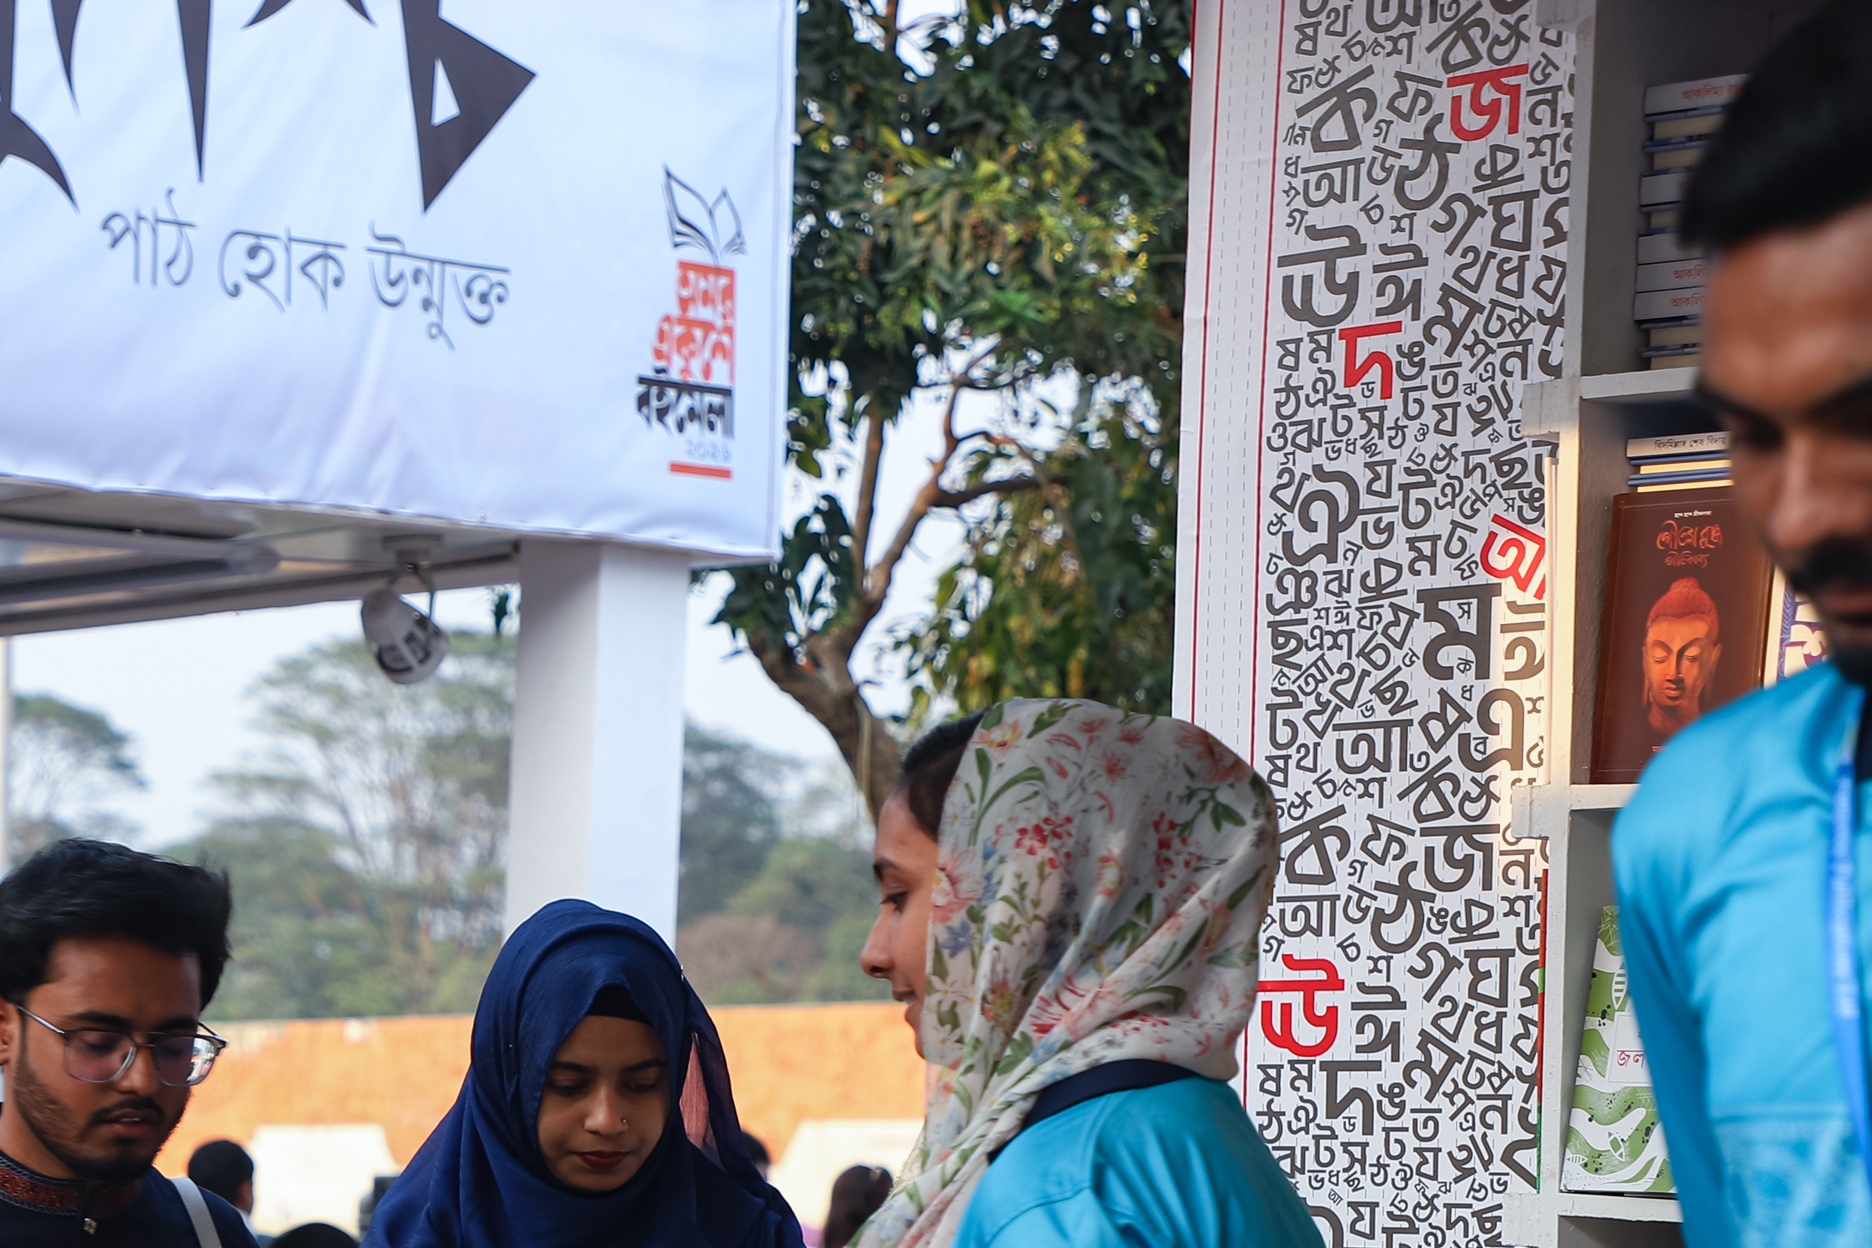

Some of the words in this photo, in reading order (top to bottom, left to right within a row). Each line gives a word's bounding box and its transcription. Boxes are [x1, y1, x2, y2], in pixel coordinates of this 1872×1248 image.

[1425, 3, 1490, 74] ক
[1295, 64, 1377, 153] ক
[1448, 65, 1528, 141] জ
[1525, 84, 1564, 128] ন
[1301, 157, 1365, 208] আ
[1487, 189, 1540, 252] ঘ
[100, 187, 197, 288] পাঠ
[217, 226, 348, 313] হোক
[365, 220, 512, 351] উন্মুক্ত
[1277, 224, 1367, 328] ঊ
[1372, 243, 1429, 321] ঈ
[1452, 245, 1498, 294] থ
[1673, 264, 1708, 281] আকলি
[1422, 282, 1487, 358] ম
[1671, 291, 1706, 309] আকলি
[1307, 328, 1336, 364] ম
[1339, 321, 1402, 399] দ
[1461, 329, 1496, 374] শ
[636, 366, 734, 438] বইমেলা
[1305, 367, 1336, 408] ঐ
[1429, 362, 1462, 399] ত
[1289, 417, 1327, 453] ঝ
[1329, 393, 1356, 437] ট
[1358, 405, 1388, 440] স
[1269, 467, 1312, 514] থ
[1363, 459, 1397, 499] য
[1461, 448, 1491, 484] দ
[1282, 464, 1360, 566] ঐ
[1398, 466, 1437, 530] ট
[1434, 473, 1464, 510] ঐ
[1405, 534, 1442, 576] ম
[1480, 514, 1545, 600] আ
[1267, 617, 1307, 671] ছ
[1380, 601, 1421, 650] য
[1416, 581, 1502, 680] ম
[1291, 652, 1335, 697] আ
[1329, 662, 1372, 709] থ
[1369, 665, 1419, 717] ছ
[1266, 687, 1303, 751] ট
[1458, 688, 1524, 773] এ
[1332, 719, 1414, 774] আ
[1397, 755, 1461, 824] ক
[1279, 804, 1351, 886] ক
[1420, 824, 1500, 892] জ
[1499, 849, 1534, 889] ন
[1276, 894, 1341, 938] আ
[1501, 895, 1533, 928] শ
[1464, 948, 1516, 1008] ঘ
[1256, 954, 1344, 1057] ঊ
[1351, 982, 1407, 1062] ঈ
[1430, 995, 1475, 1043] থ
[1402, 1028, 1465, 1103] ম
[1287, 1096, 1318, 1135] ঐ
[1319, 1060, 1382, 1136] দ
[1476, 1094, 1512, 1134] ন
[1312, 1123, 1338, 1168] ট
[1410, 1108, 1442, 1142] ত
[1347, 1201, 1379, 1240] য
[1443, 1203, 1473, 1238] দ
